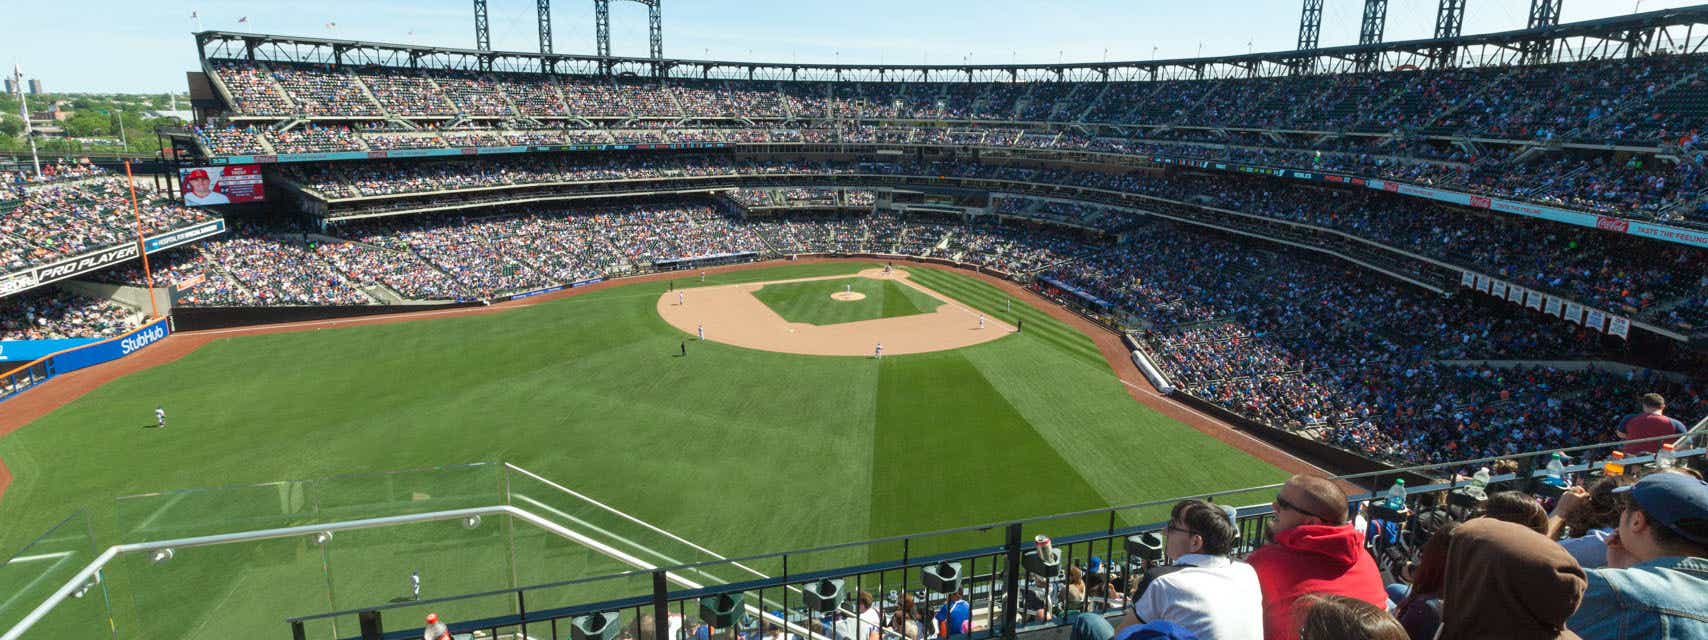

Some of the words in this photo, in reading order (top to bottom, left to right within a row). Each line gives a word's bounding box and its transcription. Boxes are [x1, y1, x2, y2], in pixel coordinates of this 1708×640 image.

[1638, 226, 1658, 235] TASTE
[1661, 230, 1673, 238] THE
[39, 262, 77, 281] PRO
[78, 246, 136, 270] PLAYER
[121, 325, 164, 354] StubHub
